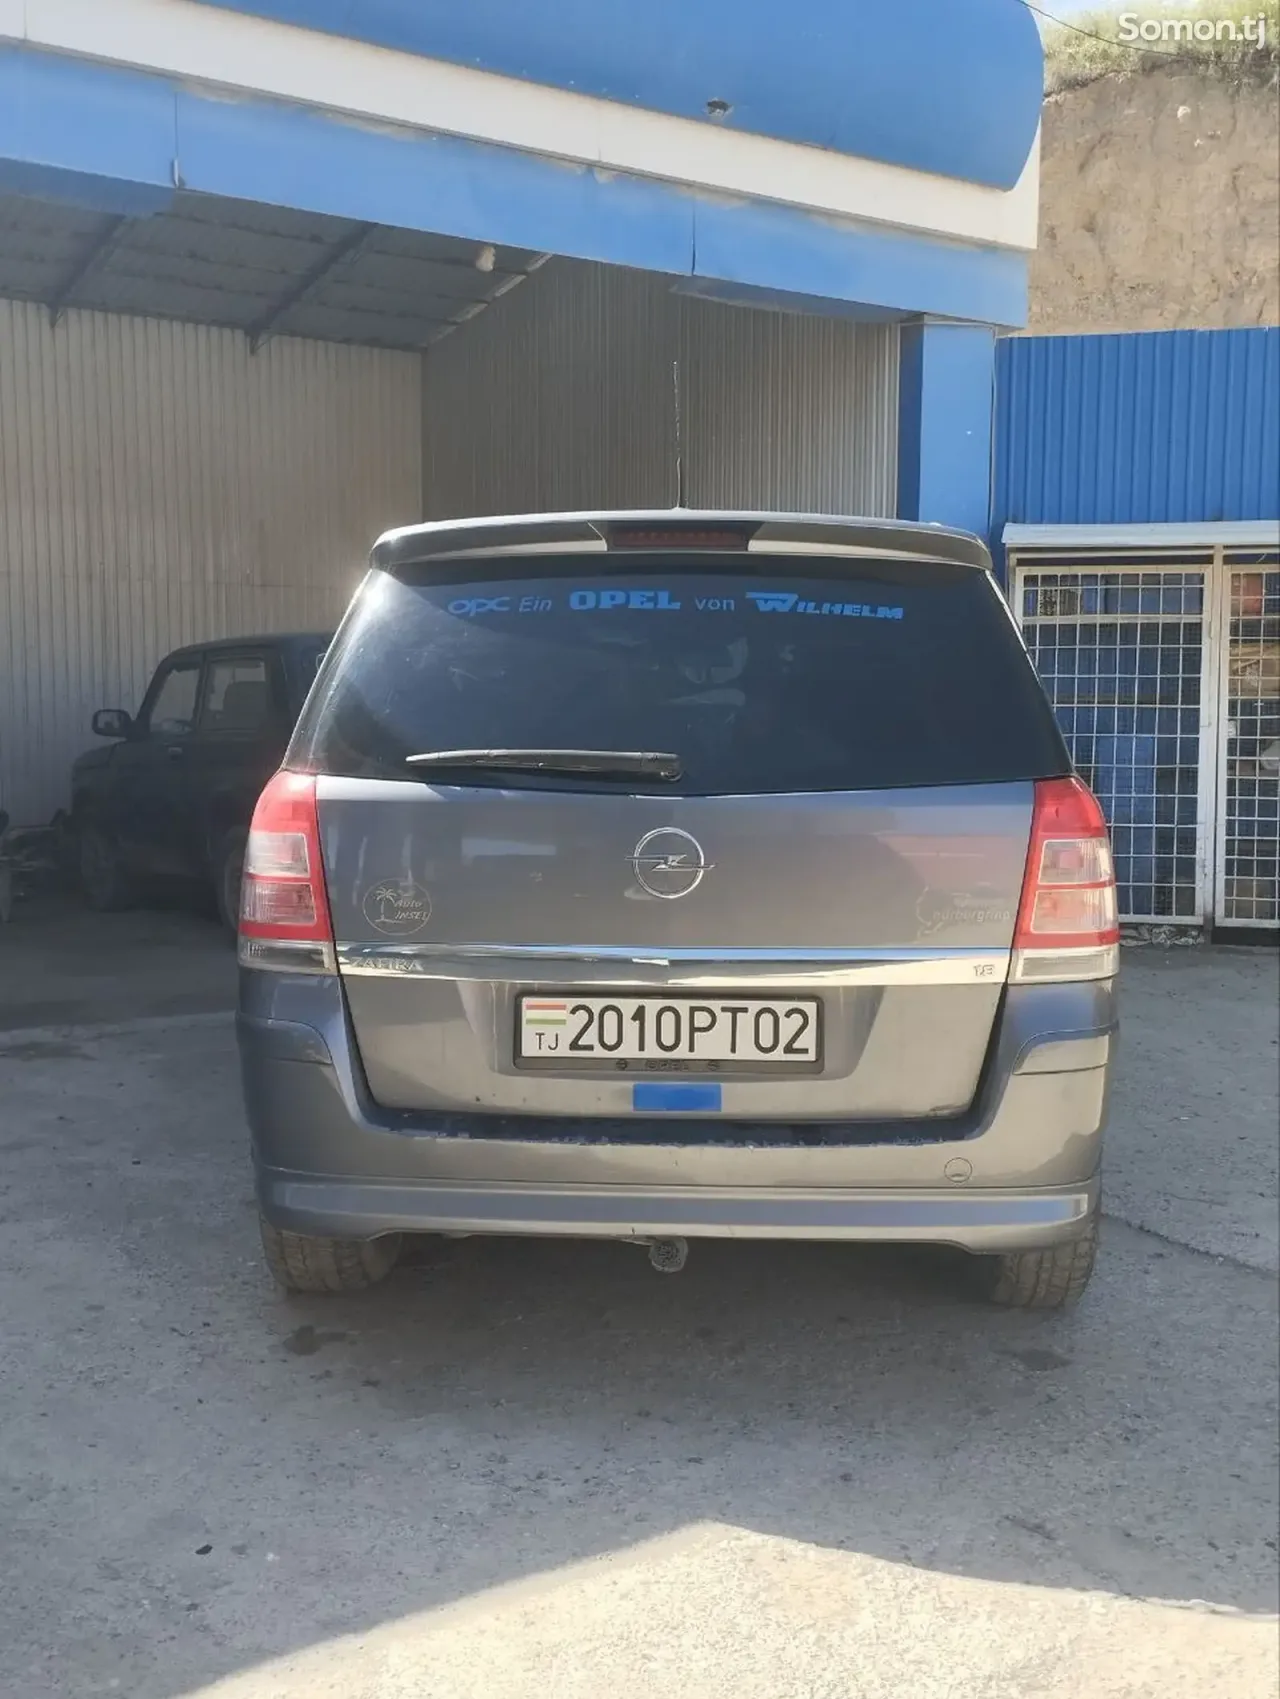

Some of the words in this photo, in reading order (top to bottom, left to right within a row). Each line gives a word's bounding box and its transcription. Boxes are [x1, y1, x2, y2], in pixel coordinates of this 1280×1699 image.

[518, 596, 552, 612] Ein
[569, 590, 681, 610] OPEL
[695, 597, 735, 611] von
[351, 957, 424, 972] ZAFIRA
[568, 1004, 810, 1055] 2010PT02
[535, 1032, 559, 1051] TJ
